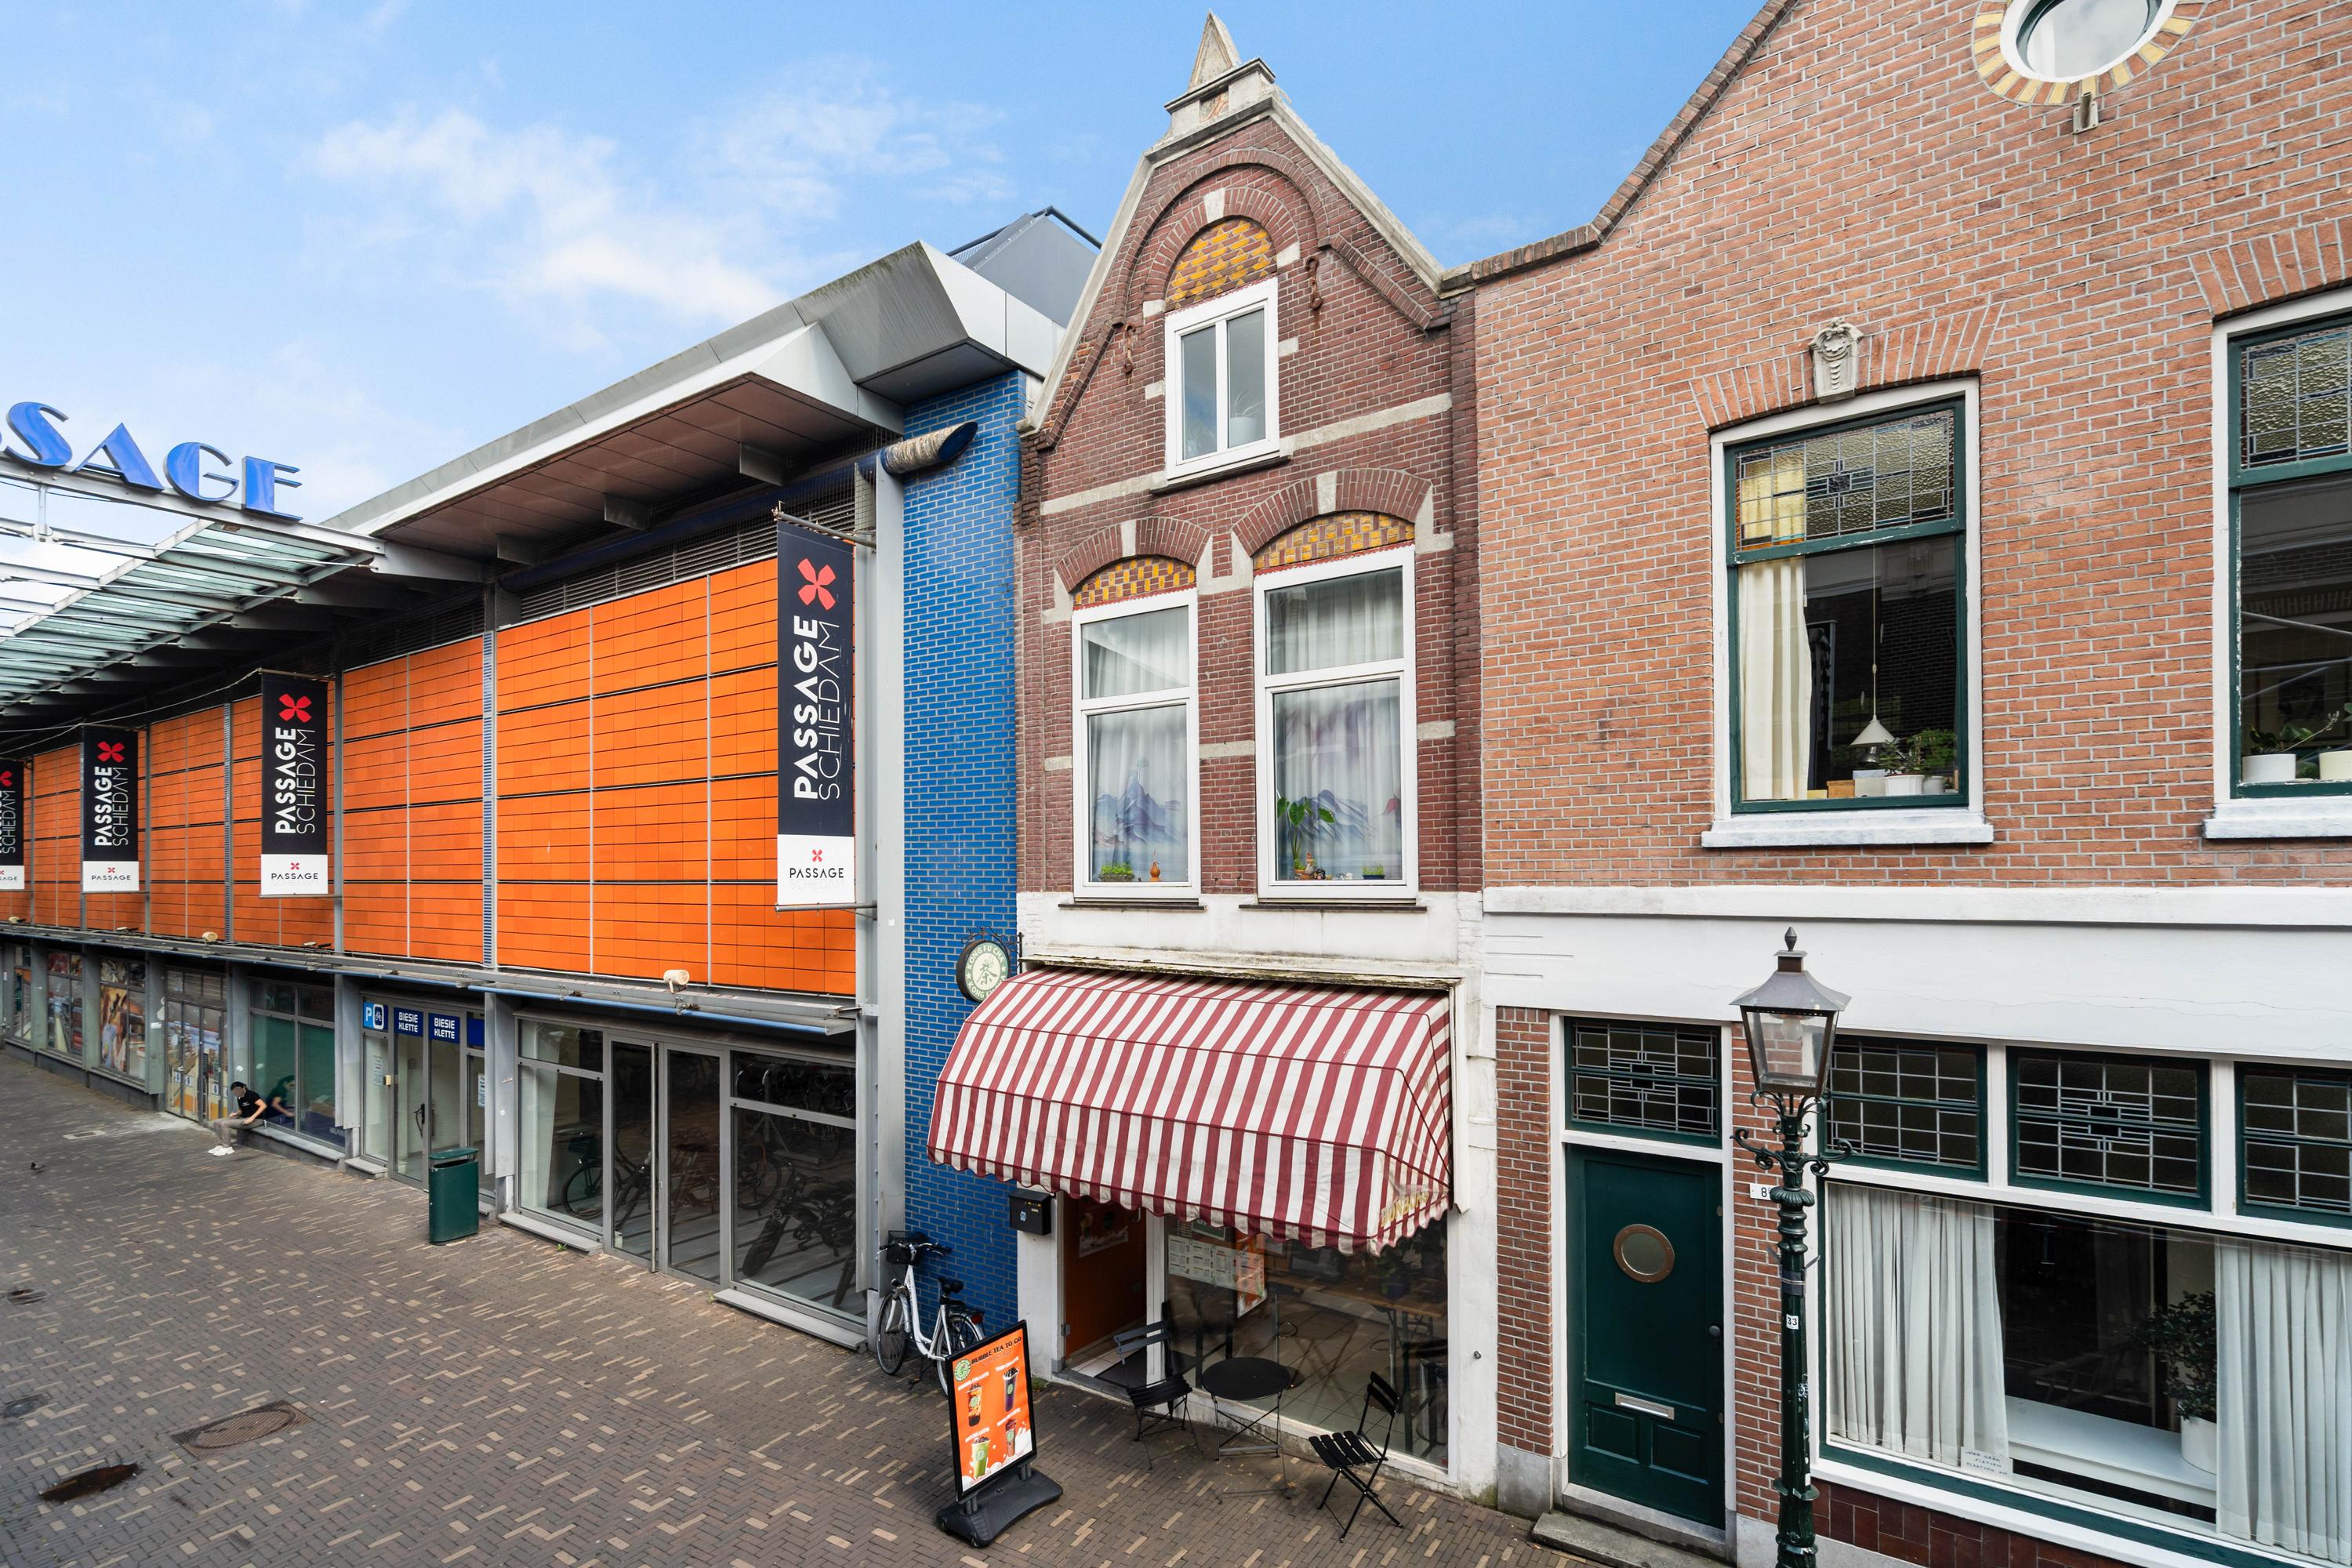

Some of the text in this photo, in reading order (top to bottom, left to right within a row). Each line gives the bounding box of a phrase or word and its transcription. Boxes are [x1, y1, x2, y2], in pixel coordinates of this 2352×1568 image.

[0, 401, 303, 522] SAGE
[793, 615, 818, 799] PASSAGE
[818, 620, 840, 801] SCHIEDAM
[275, 727, 296, 834] PASSAGE
[296, 728, 315, 834] SCHIEDAM
[95, 766, 112, 846] PASSAGE
[112, 767, 129, 847] SCHIEDAM
[2, 790, 16, 854] SCHIEDAM
[789, 867, 844, 879] PASSAGE
[967, 946, 983, 970] KONG
[993, 947, 1004, 964] CHA
[968, 981, 985, 999] KONG
[365, 1007, 372, 1022] P
[398, 1011, 419, 1023] BIESIE
[434, 1017, 456, 1029] BIESIE
[398, 1022, 419, 1033] KLETTE
[434, 1028, 456, 1040] KLETTE
[1788, 1316, 1798, 1326] 33
[971, 1350, 992, 1364] BUBBLE
[993, 1345, 1004, 1353] TEA
